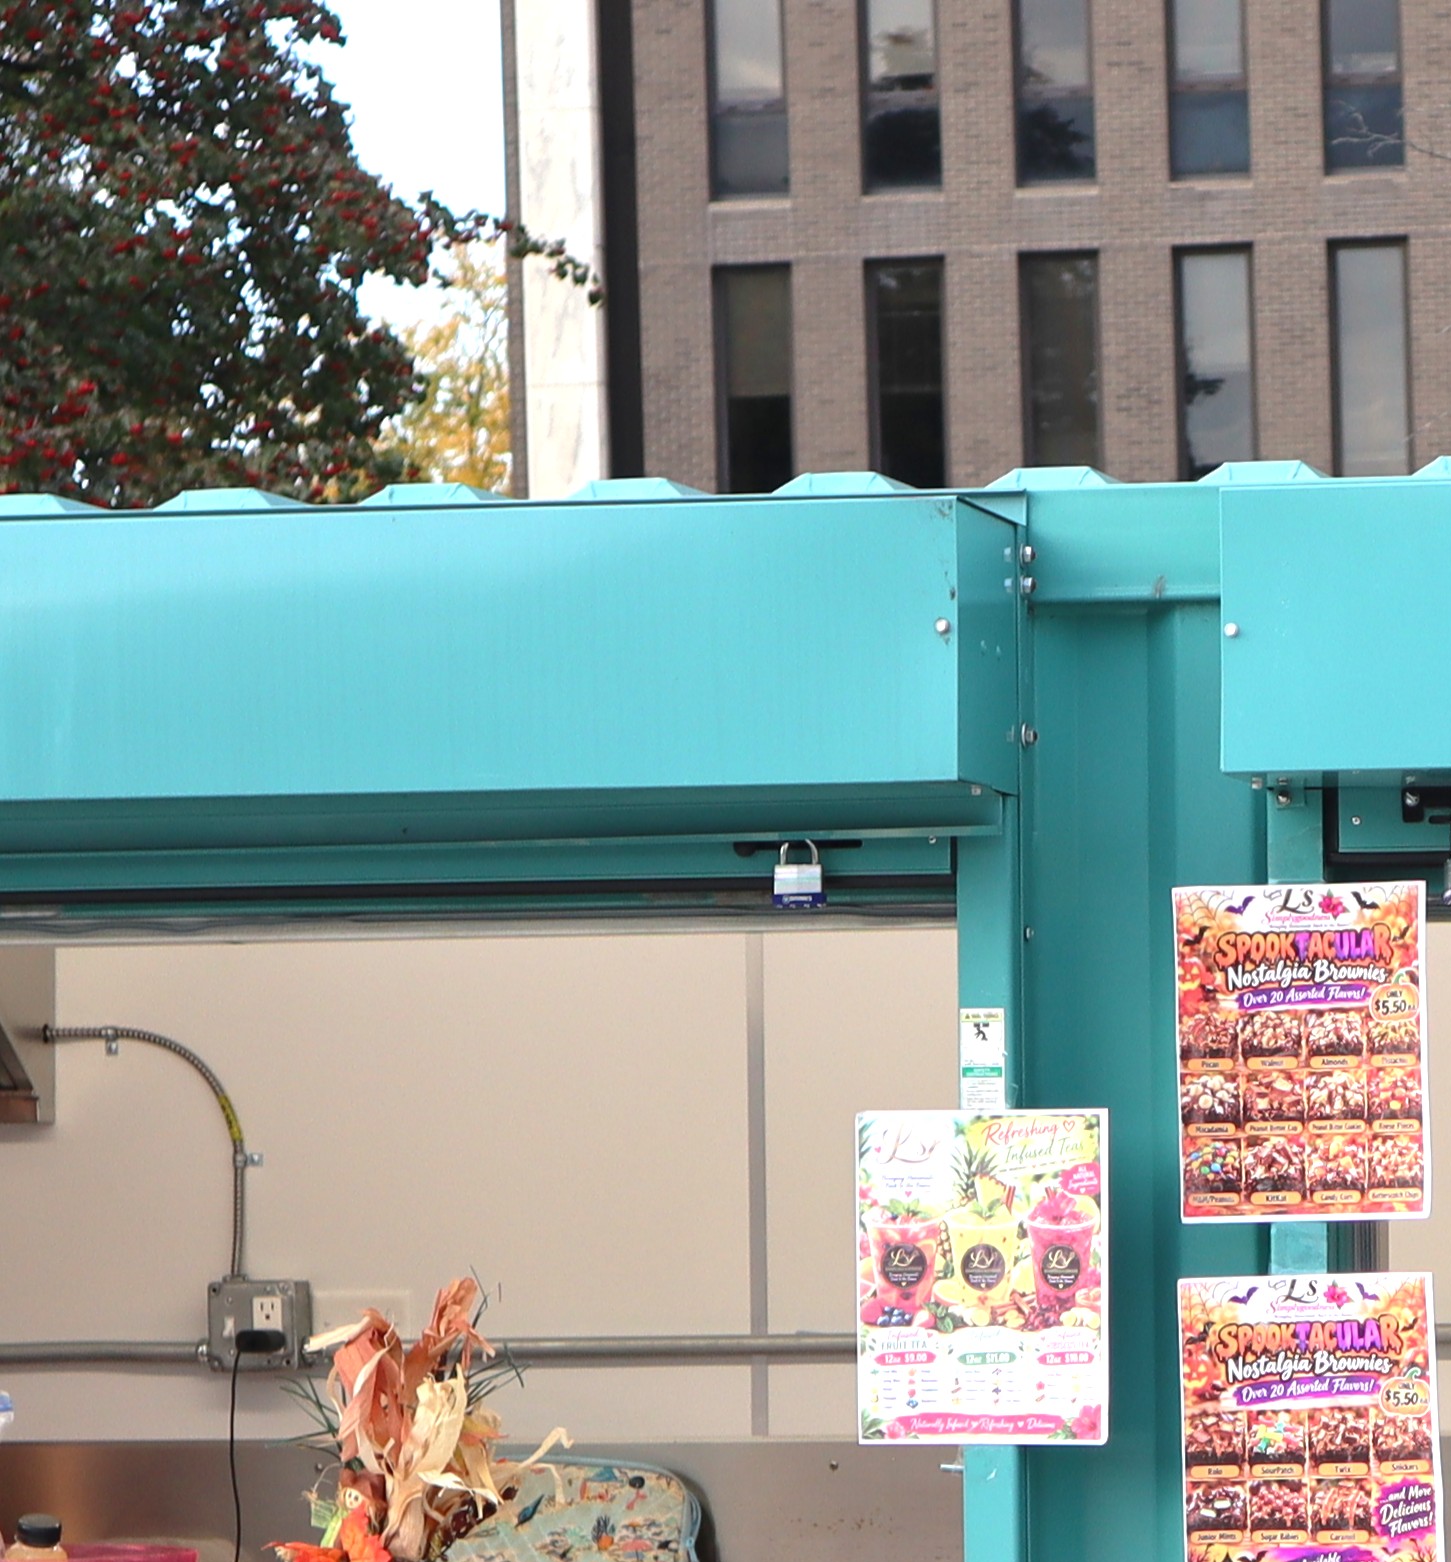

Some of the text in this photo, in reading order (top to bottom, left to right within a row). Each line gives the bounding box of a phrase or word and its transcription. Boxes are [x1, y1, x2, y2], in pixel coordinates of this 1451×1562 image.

[1214, 923, 1394, 969] SPOOKTACULAR
[1227, 959, 1388, 990] Nostalgia Brownies
[1243, 986, 1365, 1007] Over 20 Assorted Flavors!
[1375, 999, 1407, 1015] $5.50
[980, 1118, 1059, 1146] Refreshing
[1004, 1136, 1084, 1164] Infused Teas
[1277, 1279, 1318, 1304] Ls
[1215, 1314, 1403, 1361] SPOOKTACULAR
[904, 1352, 928, 1363] $9.00
[1227, 1350, 1393, 1383] Nostalgia Brownies
[1241, 1378, 1374, 1401] Over 20 Assorted Flavors!
[1385, 1389, 1419, 1406] $5.50
[1408, 1485, 1432, 1500] More
[1380, 1499, 1432, 1525] Delicious
[1389, 1511, 1434, 1538] Flavors!
